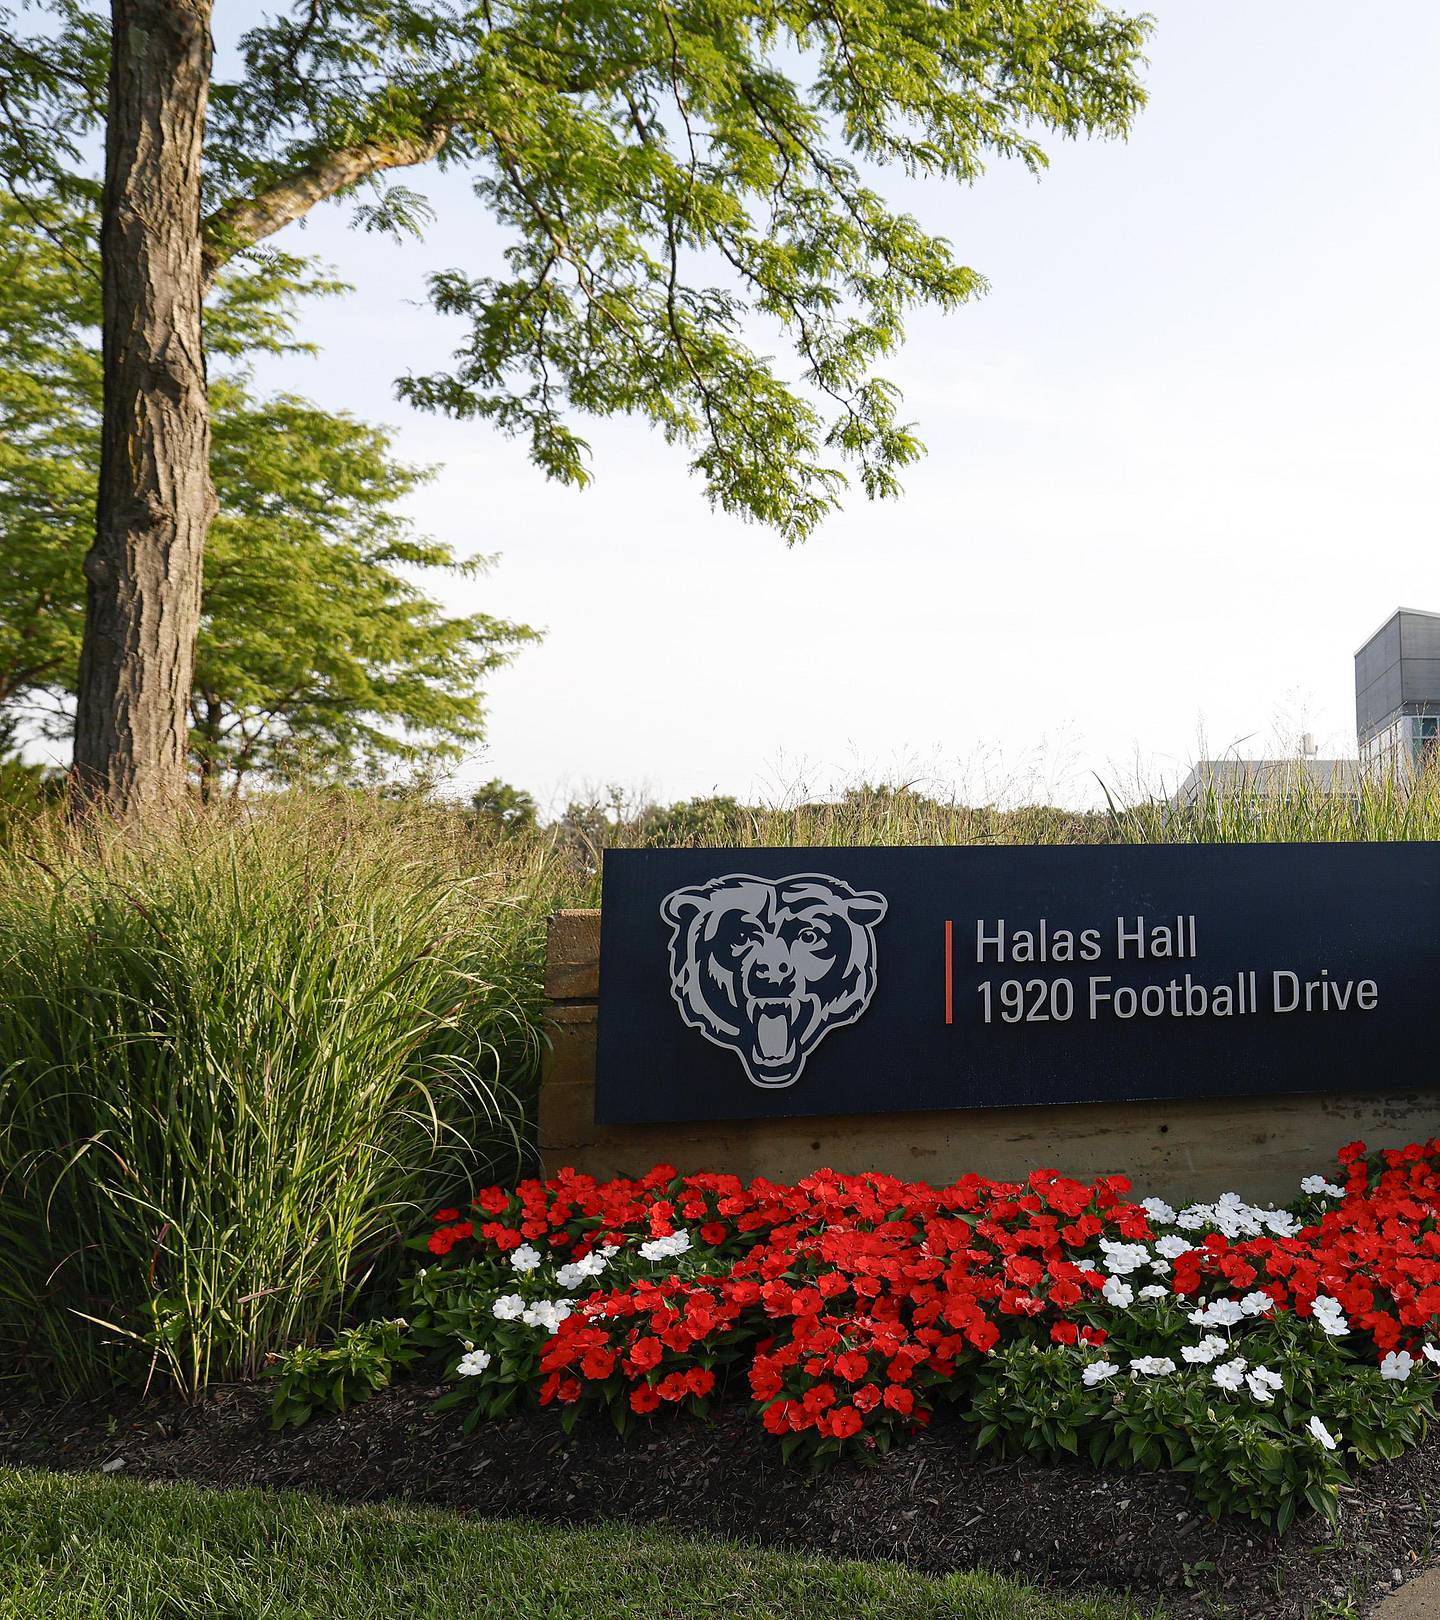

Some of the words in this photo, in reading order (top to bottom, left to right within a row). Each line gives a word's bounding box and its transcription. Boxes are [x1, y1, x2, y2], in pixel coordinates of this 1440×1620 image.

[976, 918, 1101, 963] Halas
[1116, 915, 1197, 960] Hall
[977, 978, 1075, 1024] 1920
[1089, 970, 1258, 1020] Football
[1272, 969, 1379, 1014] Drive
